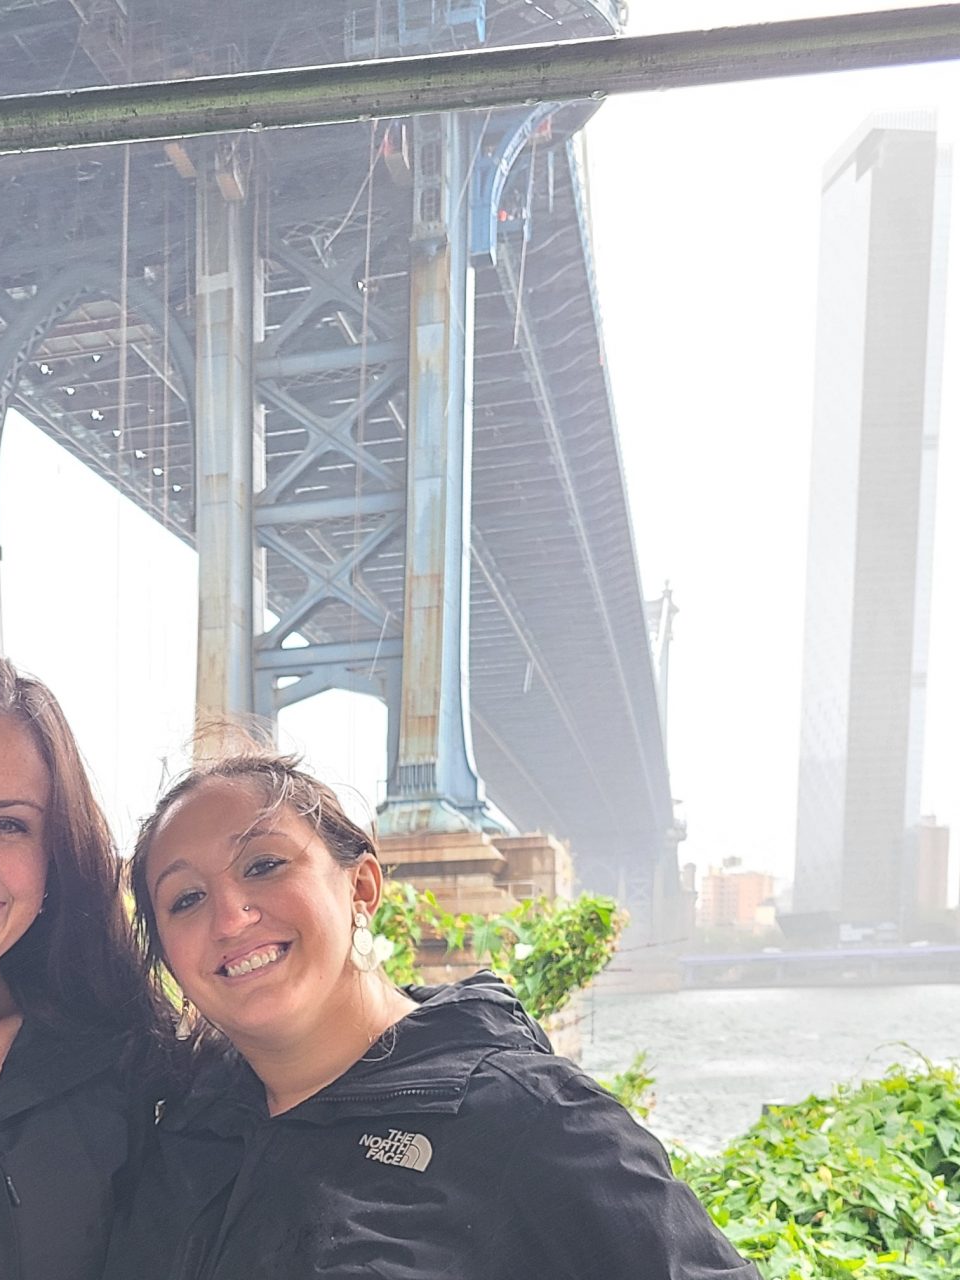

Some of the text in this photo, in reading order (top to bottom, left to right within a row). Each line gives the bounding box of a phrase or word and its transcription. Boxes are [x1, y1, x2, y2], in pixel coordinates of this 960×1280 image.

[359, 1134, 408, 1154] NORTH
[388, 1129, 415, 1144] THE
[366, 1148, 403, 1166] FACE
